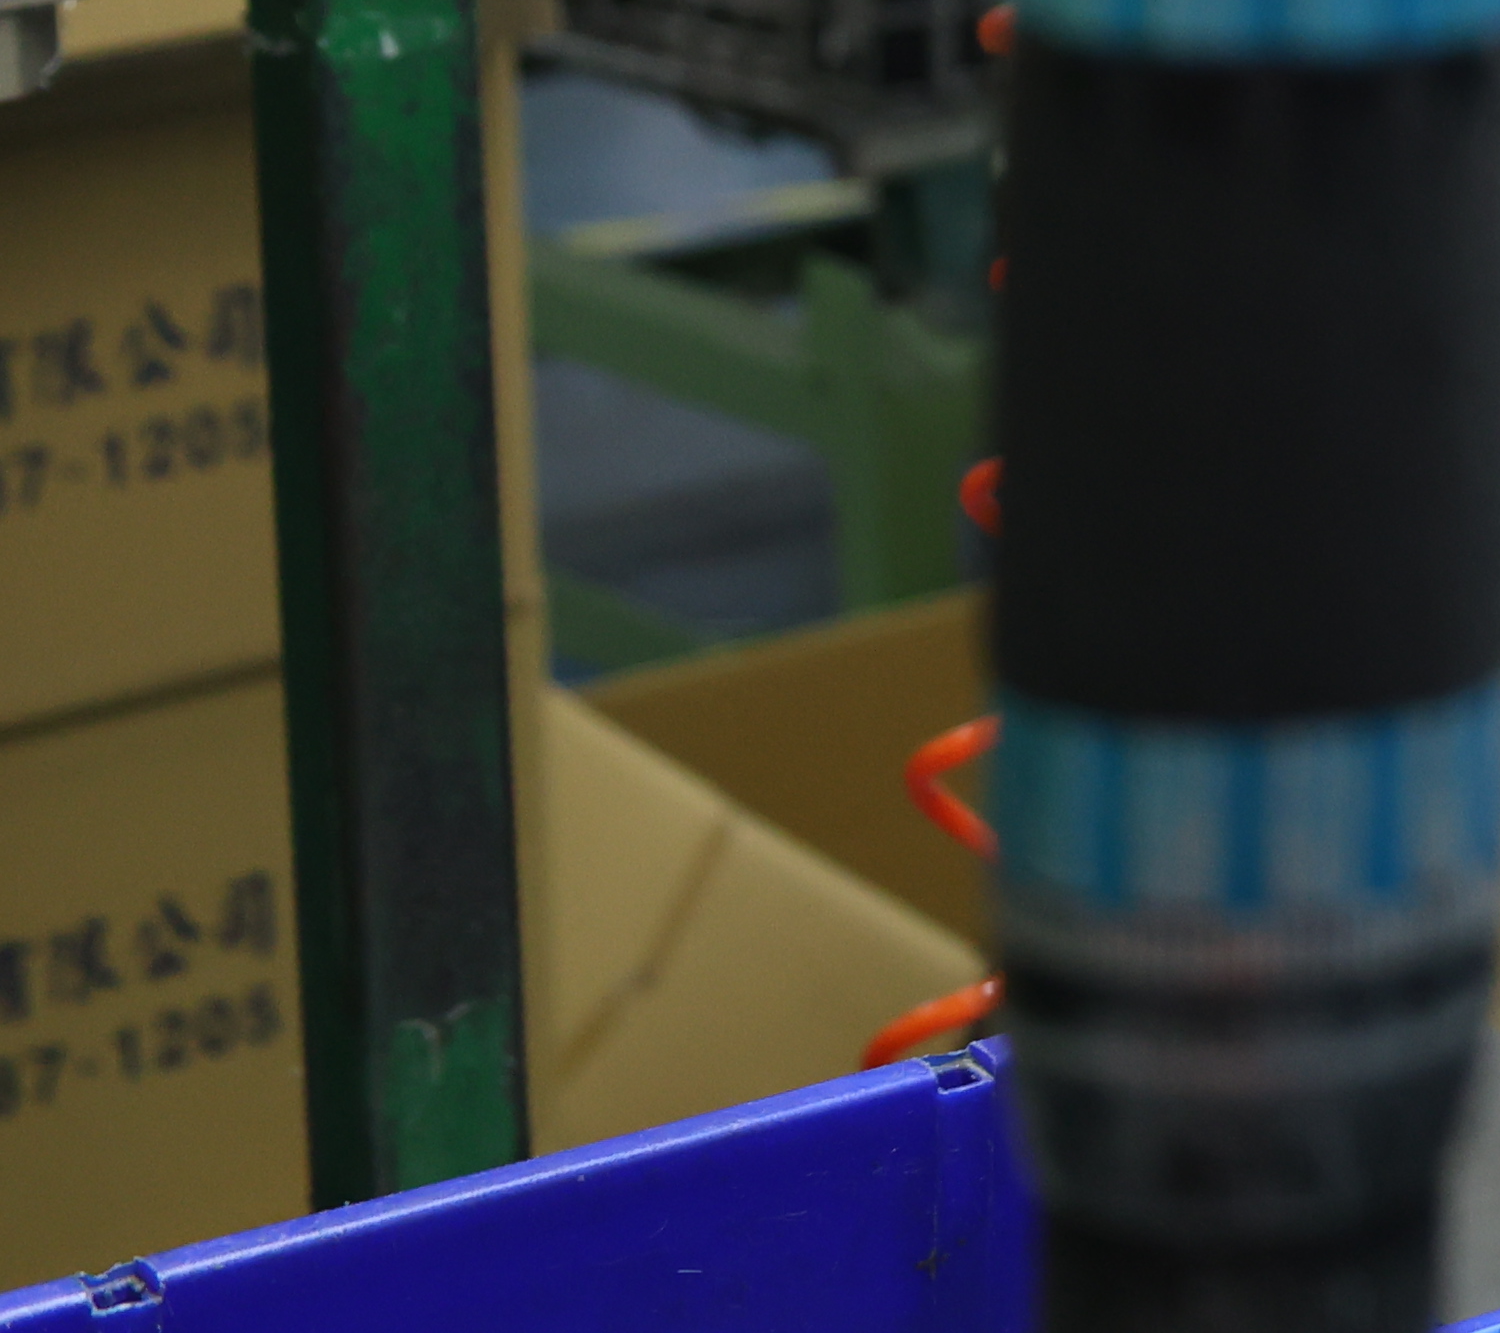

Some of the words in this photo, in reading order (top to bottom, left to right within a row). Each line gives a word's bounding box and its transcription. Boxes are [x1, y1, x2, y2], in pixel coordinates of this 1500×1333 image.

[0, 283, 260, 423] 限公司
[0, 397, 264, 515] 7-1205
